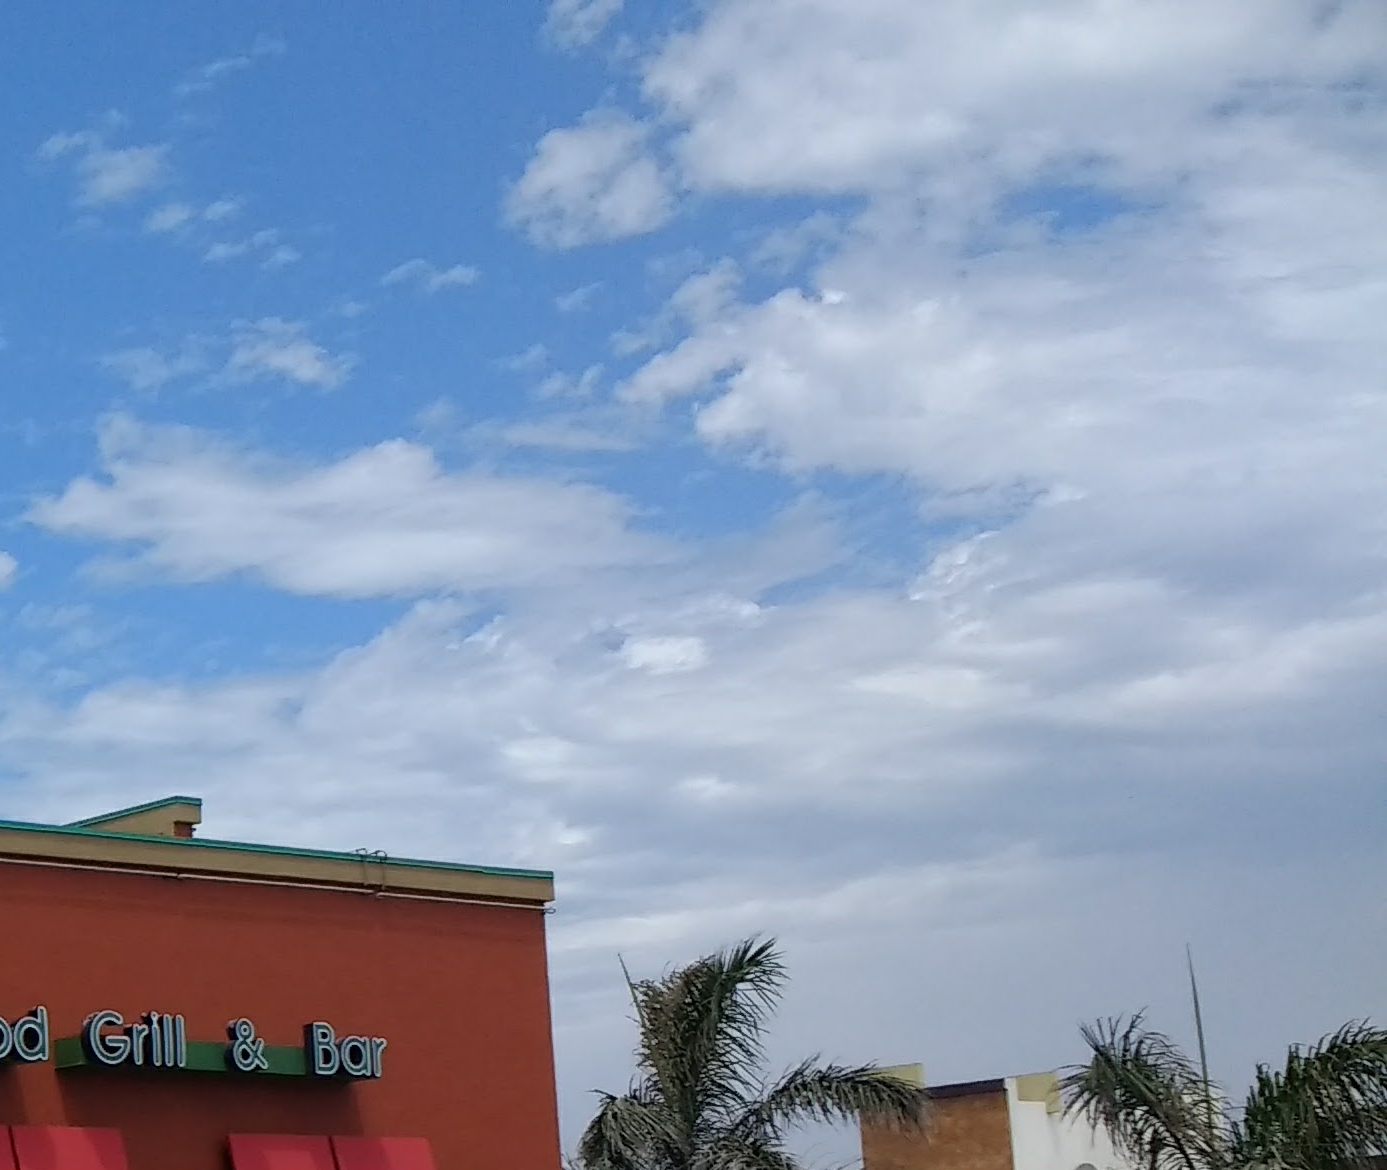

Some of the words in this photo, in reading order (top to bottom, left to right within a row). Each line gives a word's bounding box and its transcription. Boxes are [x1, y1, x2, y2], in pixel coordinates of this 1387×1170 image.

[89, 1009, 187, 1068] Grill
[232, 1017, 269, 1072] &
[311, 1021, 388, 1078] Bar
